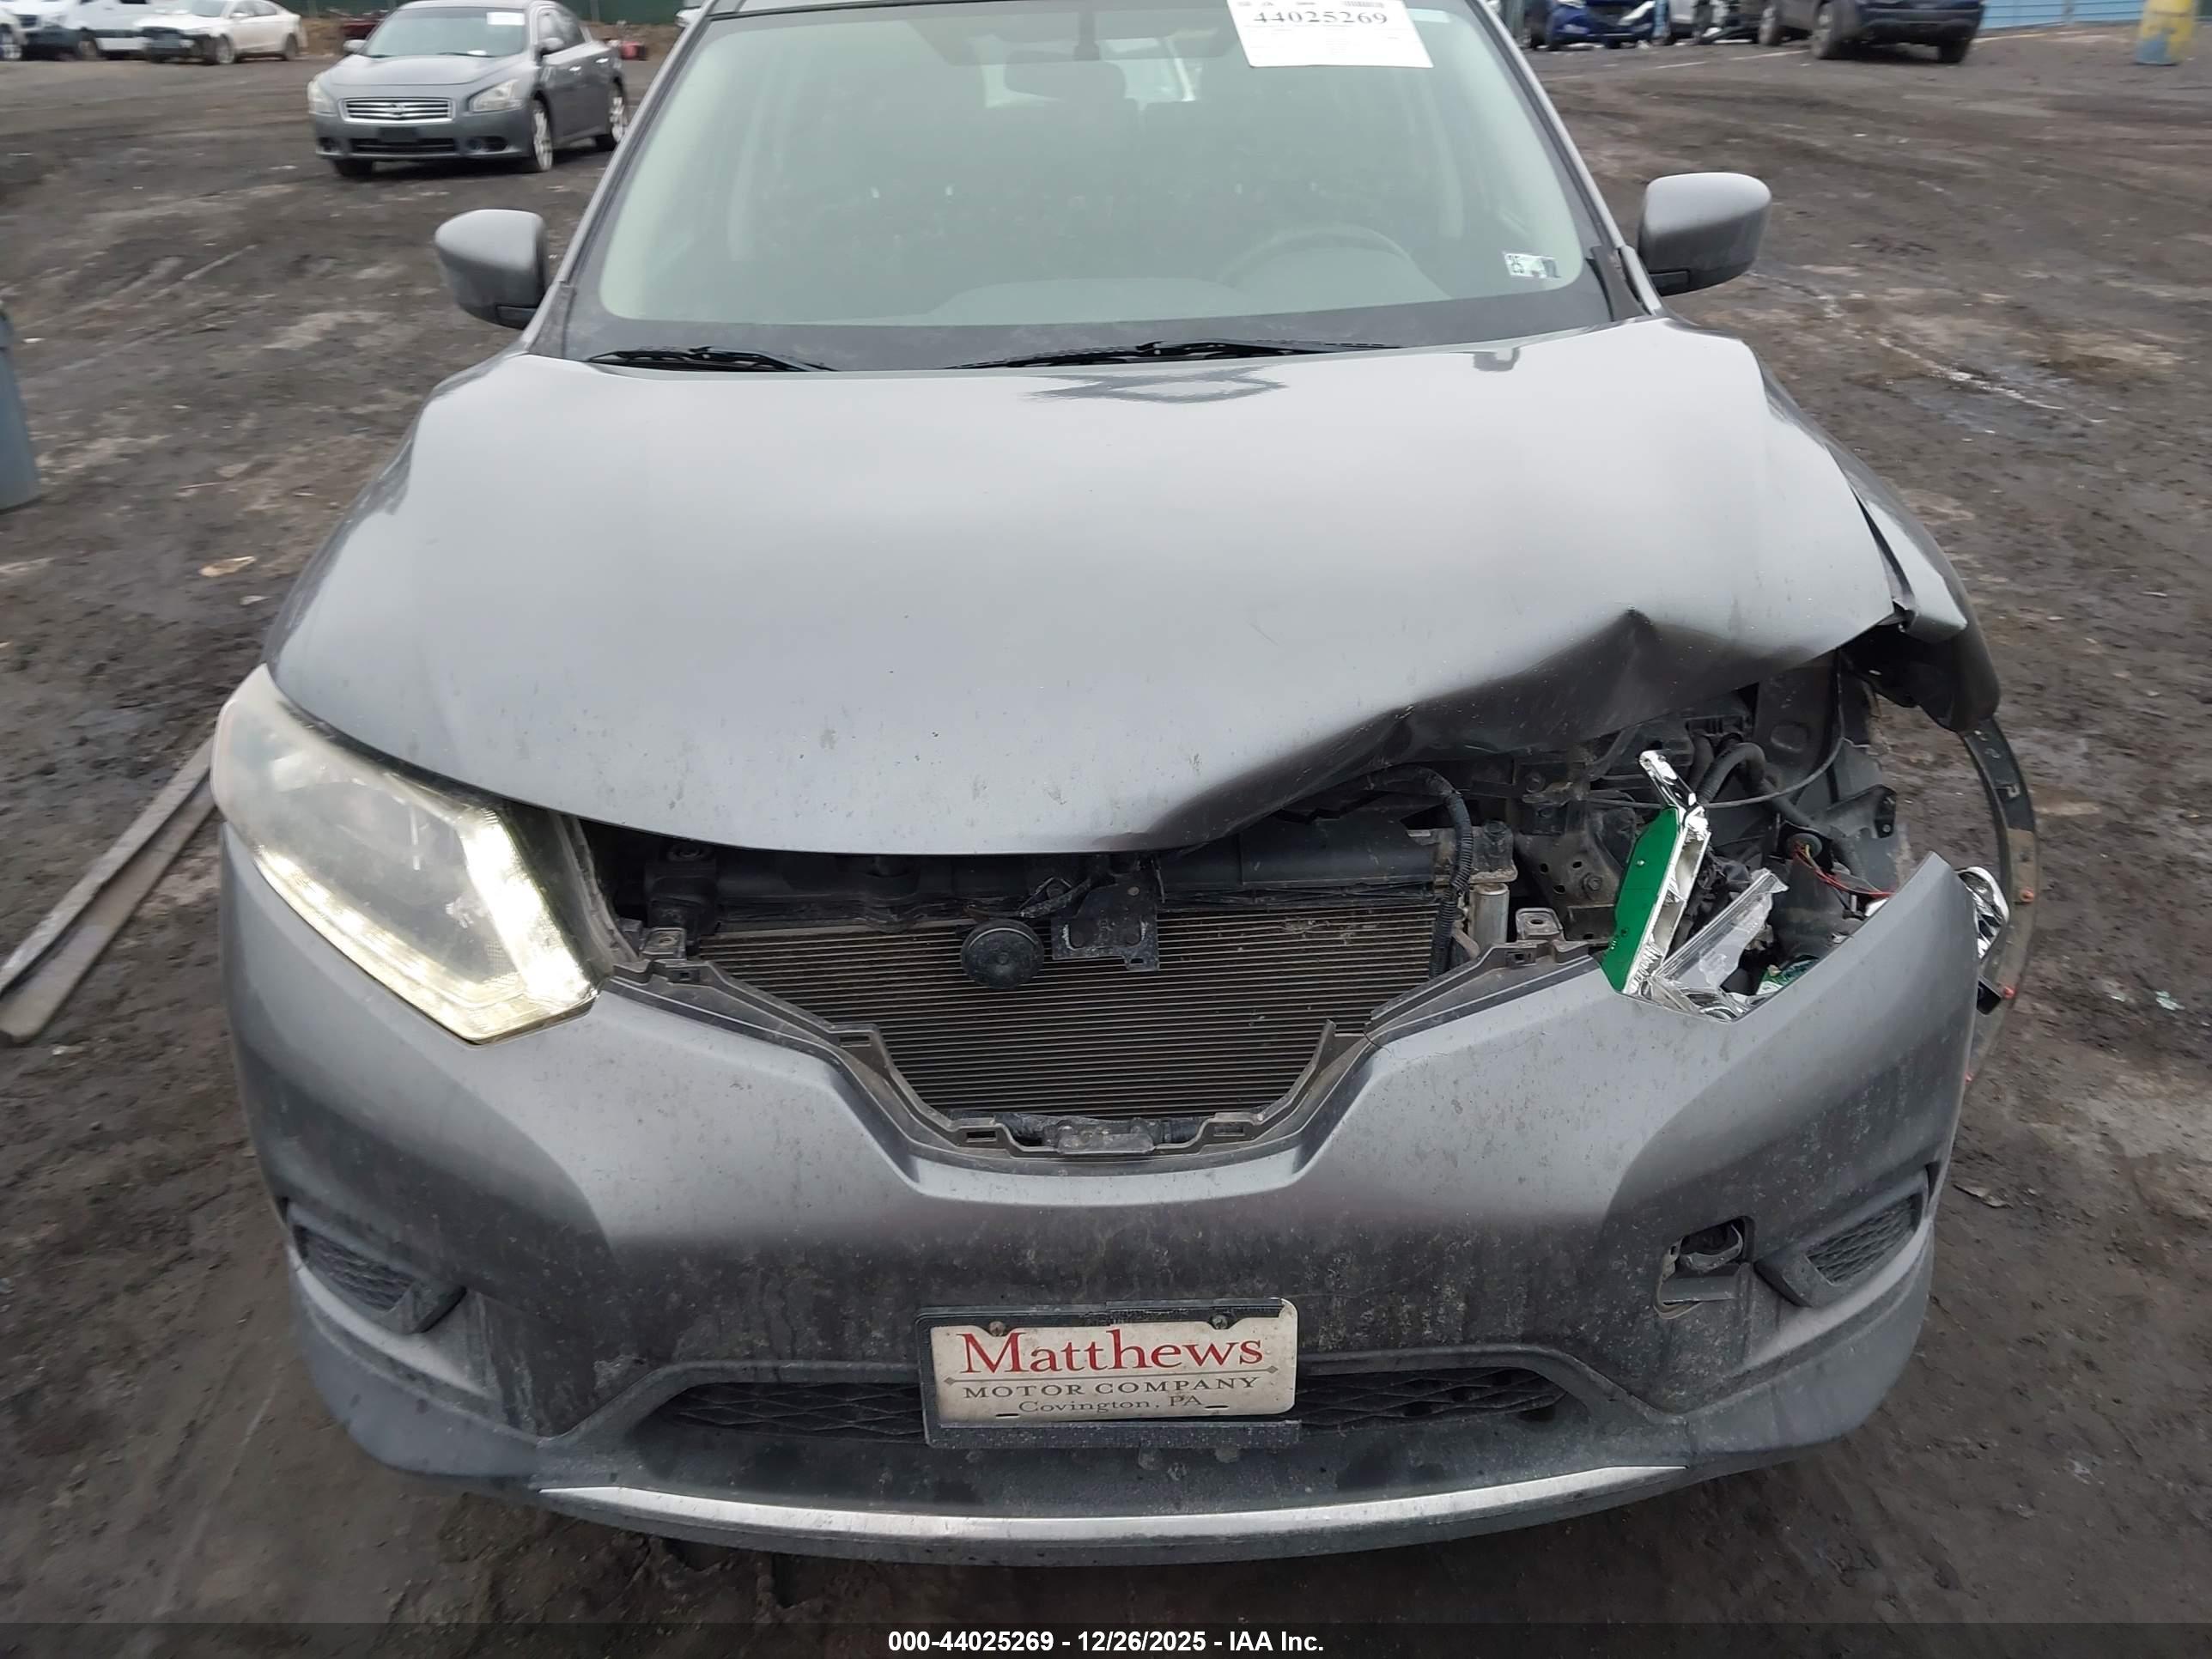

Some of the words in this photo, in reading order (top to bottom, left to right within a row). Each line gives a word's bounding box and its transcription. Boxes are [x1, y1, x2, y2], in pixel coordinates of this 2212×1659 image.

[1253, 11, 1389, 24] 44025269
[957, 1328, 1264, 1374] Matthews
[963, 1383, 1085, 1399] MOTOR
[1094, 1376, 1260, 1395] COMPANY
[1169, 1395, 1203, 1407] PA
